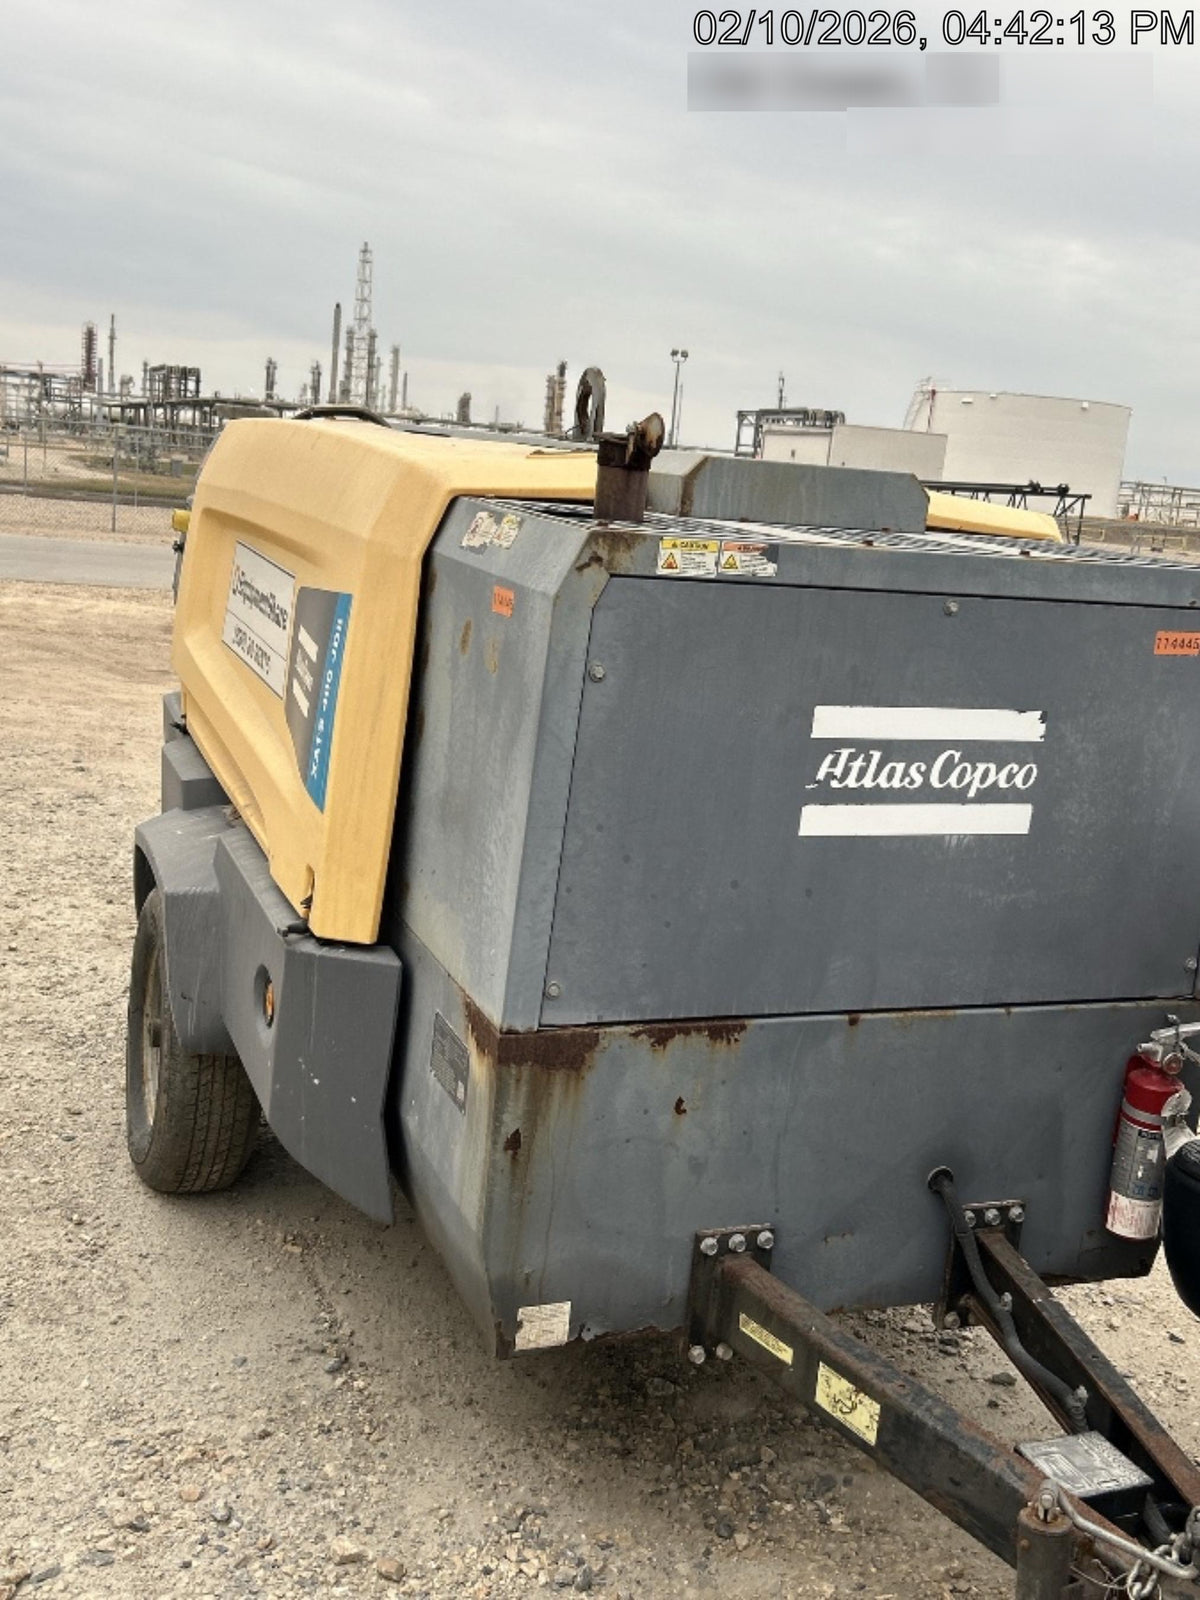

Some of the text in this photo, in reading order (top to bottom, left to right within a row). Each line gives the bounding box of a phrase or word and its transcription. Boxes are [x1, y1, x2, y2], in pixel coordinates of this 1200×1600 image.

[1156, 637, 1200, 650] 774445
[805, 747, 1039, 798] Atlas Copco
